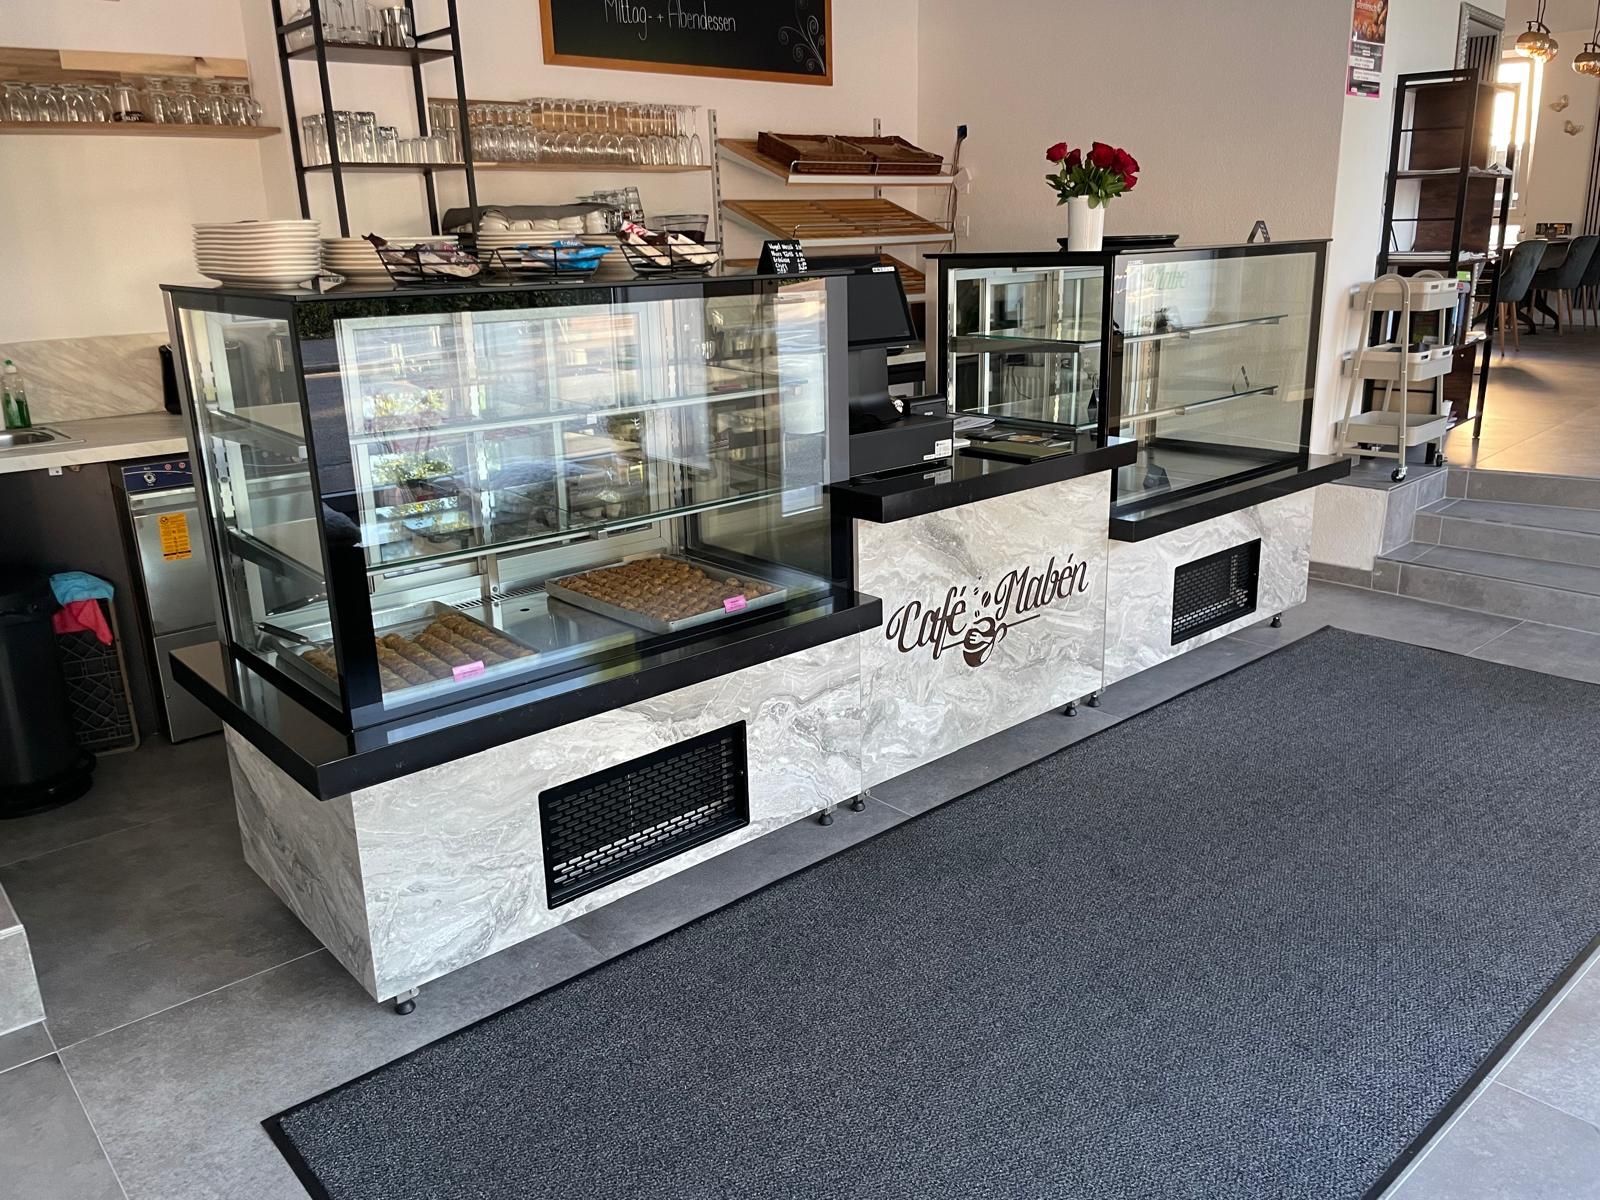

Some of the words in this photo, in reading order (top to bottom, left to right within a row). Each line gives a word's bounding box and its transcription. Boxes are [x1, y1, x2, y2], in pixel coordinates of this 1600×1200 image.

[656, 13, 665, 23] +
[667, 0, 737, 32] Abendessen
[885, 585, 967, 660] Café
[994, 553, 1089, 621] Mabén
